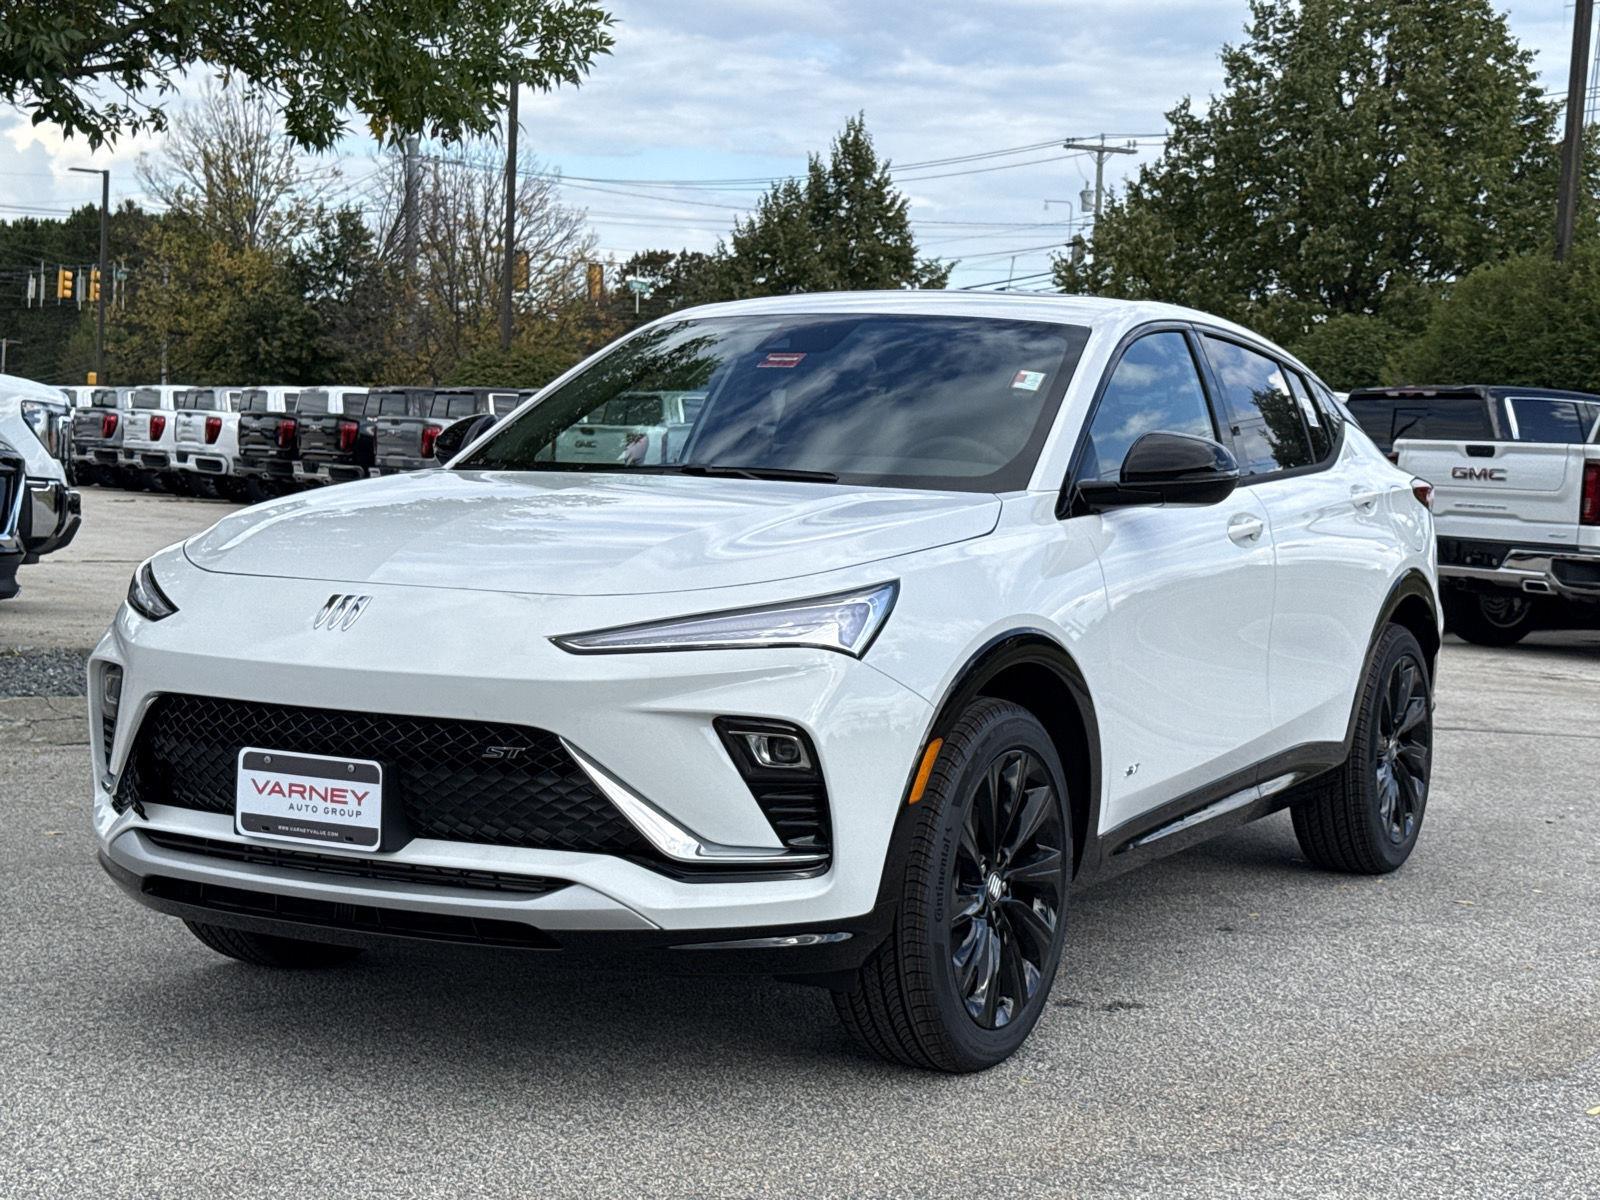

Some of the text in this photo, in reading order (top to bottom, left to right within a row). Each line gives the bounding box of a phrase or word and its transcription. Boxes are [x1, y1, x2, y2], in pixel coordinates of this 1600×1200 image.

[1451, 466, 1507, 481] GMC
[482, 746, 526, 759] ST
[251, 778, 370, 806] VARNEY
[288, 803, 363, 818] AUTO GROUP
